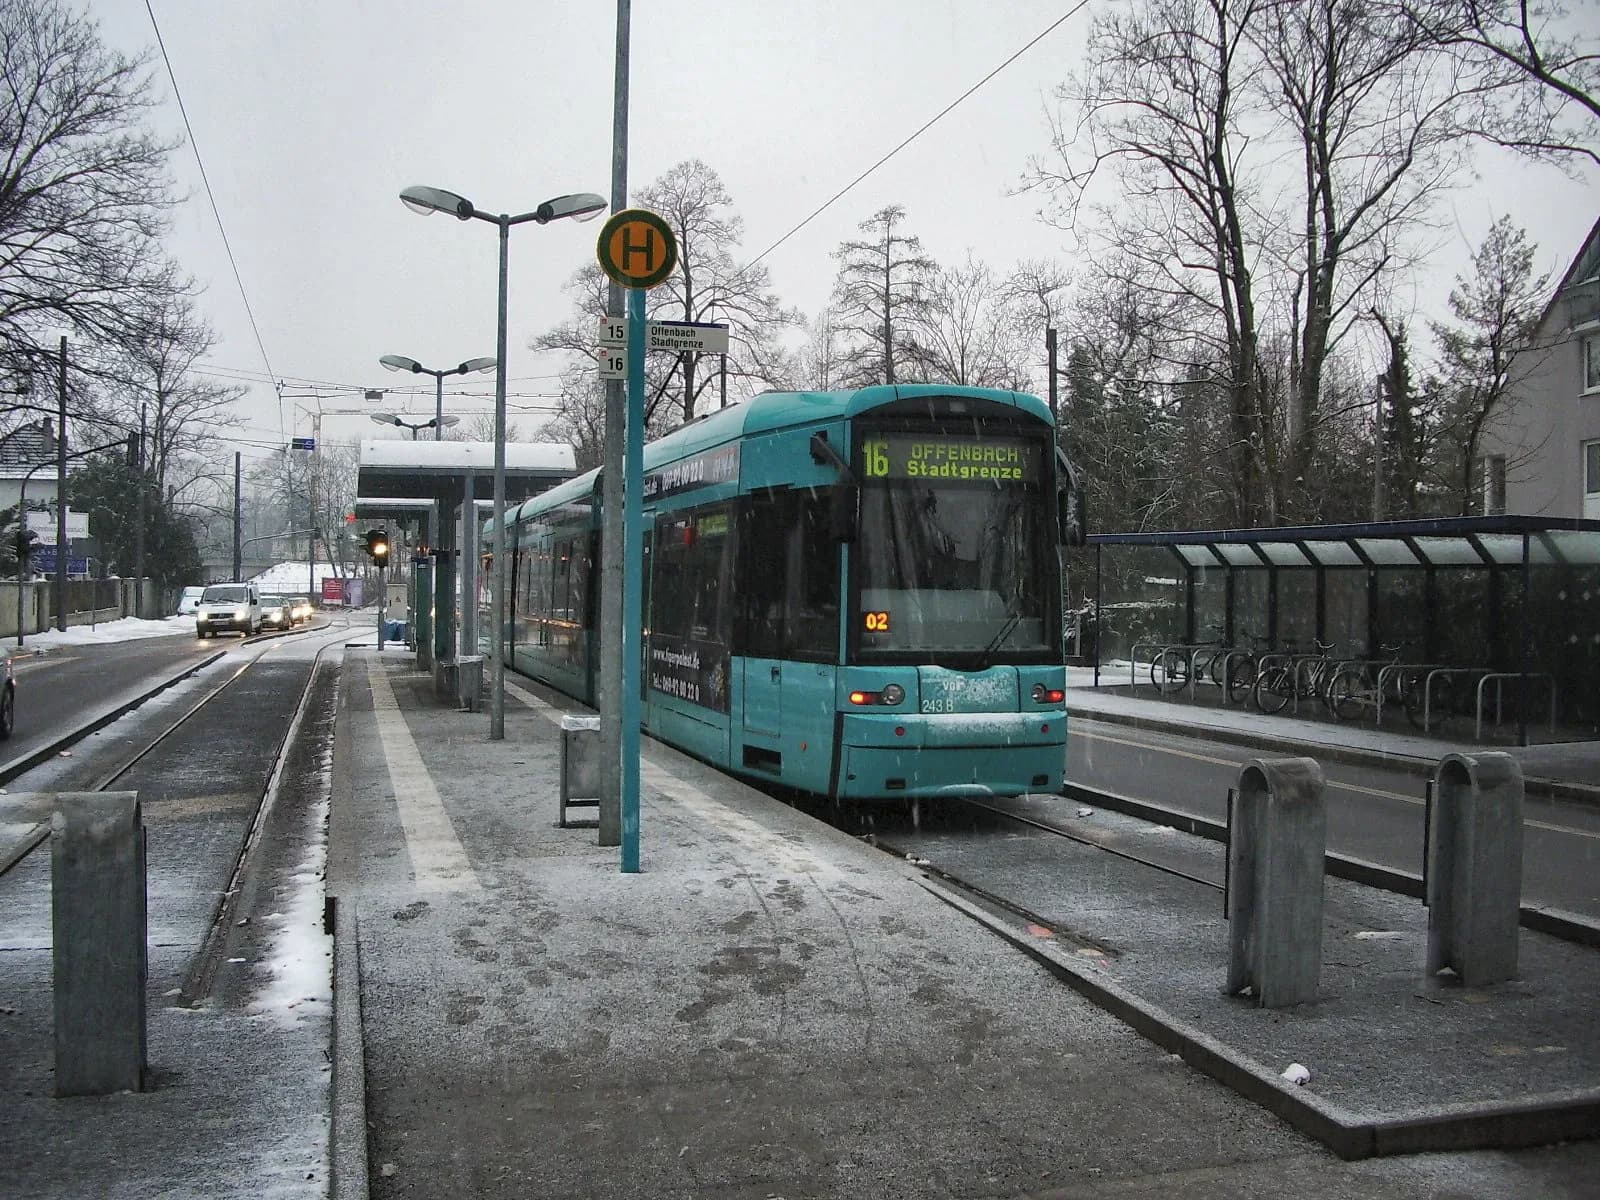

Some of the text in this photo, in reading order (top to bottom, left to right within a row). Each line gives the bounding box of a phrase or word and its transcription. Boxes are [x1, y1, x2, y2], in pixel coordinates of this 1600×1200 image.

[622, 228, 654, 272] H
[608, 325, 624, 339] 15
[651, 326, 696, 338] Offenbach
[651, 337, 704, 349] Stadtgrenze
[607, 357, 624, 371] 16
[863, 441, 890, 477] 16
[911, 443, 1020, 463] OFFENBACH
[907, 460, 1023, 480] Stadtgrenze
[865, 612, 889, 631] 02
[922, 699, 943, 713] 243
